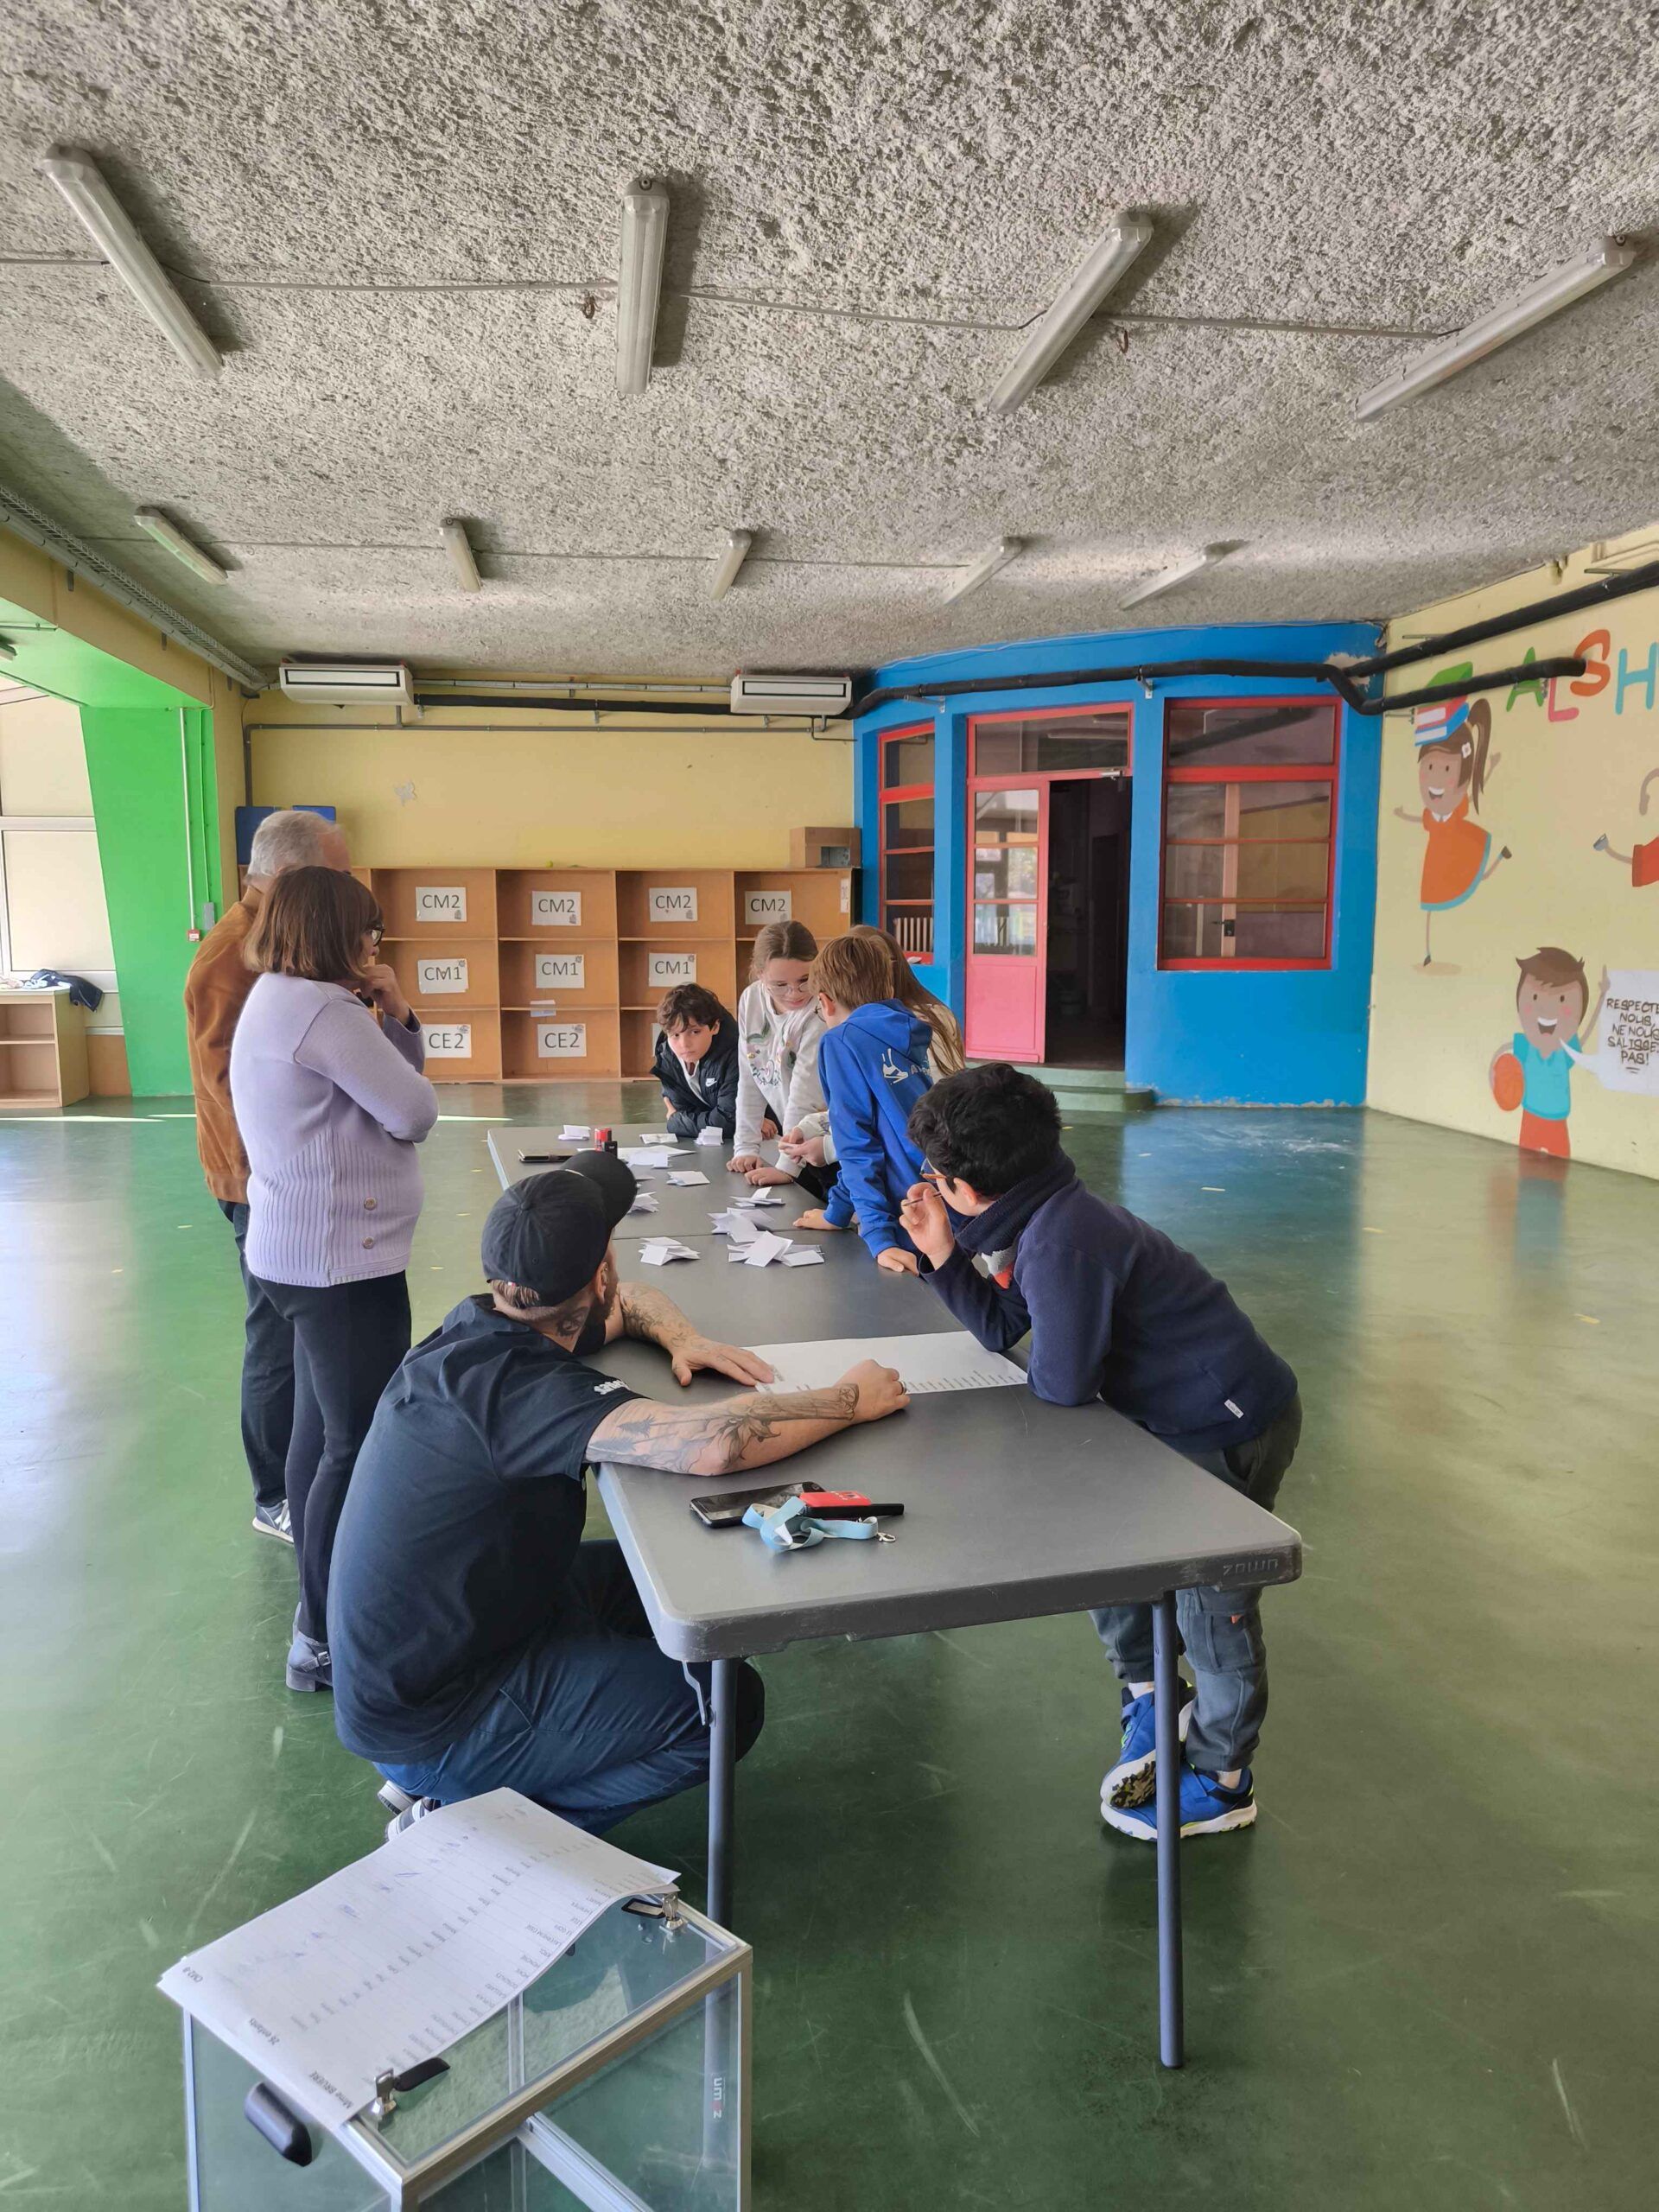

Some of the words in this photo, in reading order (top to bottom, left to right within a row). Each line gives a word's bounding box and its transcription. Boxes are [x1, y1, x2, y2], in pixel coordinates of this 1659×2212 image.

[422, 894, 461, 909] CM2
[538, 899, 575, 913] CM2
[655, 895, 692, 909] CM2
[750, 898, 786, 912] CM2
[424, 966, 462, 981] CM1
[541, 962, 579, 976] CM1
[655, 961, 691, 975] CM1
[1612, 1023, 1626, 1036] NE
[429, 1033, 464, 1049] CE2
[544, 1032, 580, 1049] CE2
[1621, 1050, 1649, 1065] PAS!
[246, 2016, 272, 2039] enfants
[334, 2089, 354, 2109] Mme
